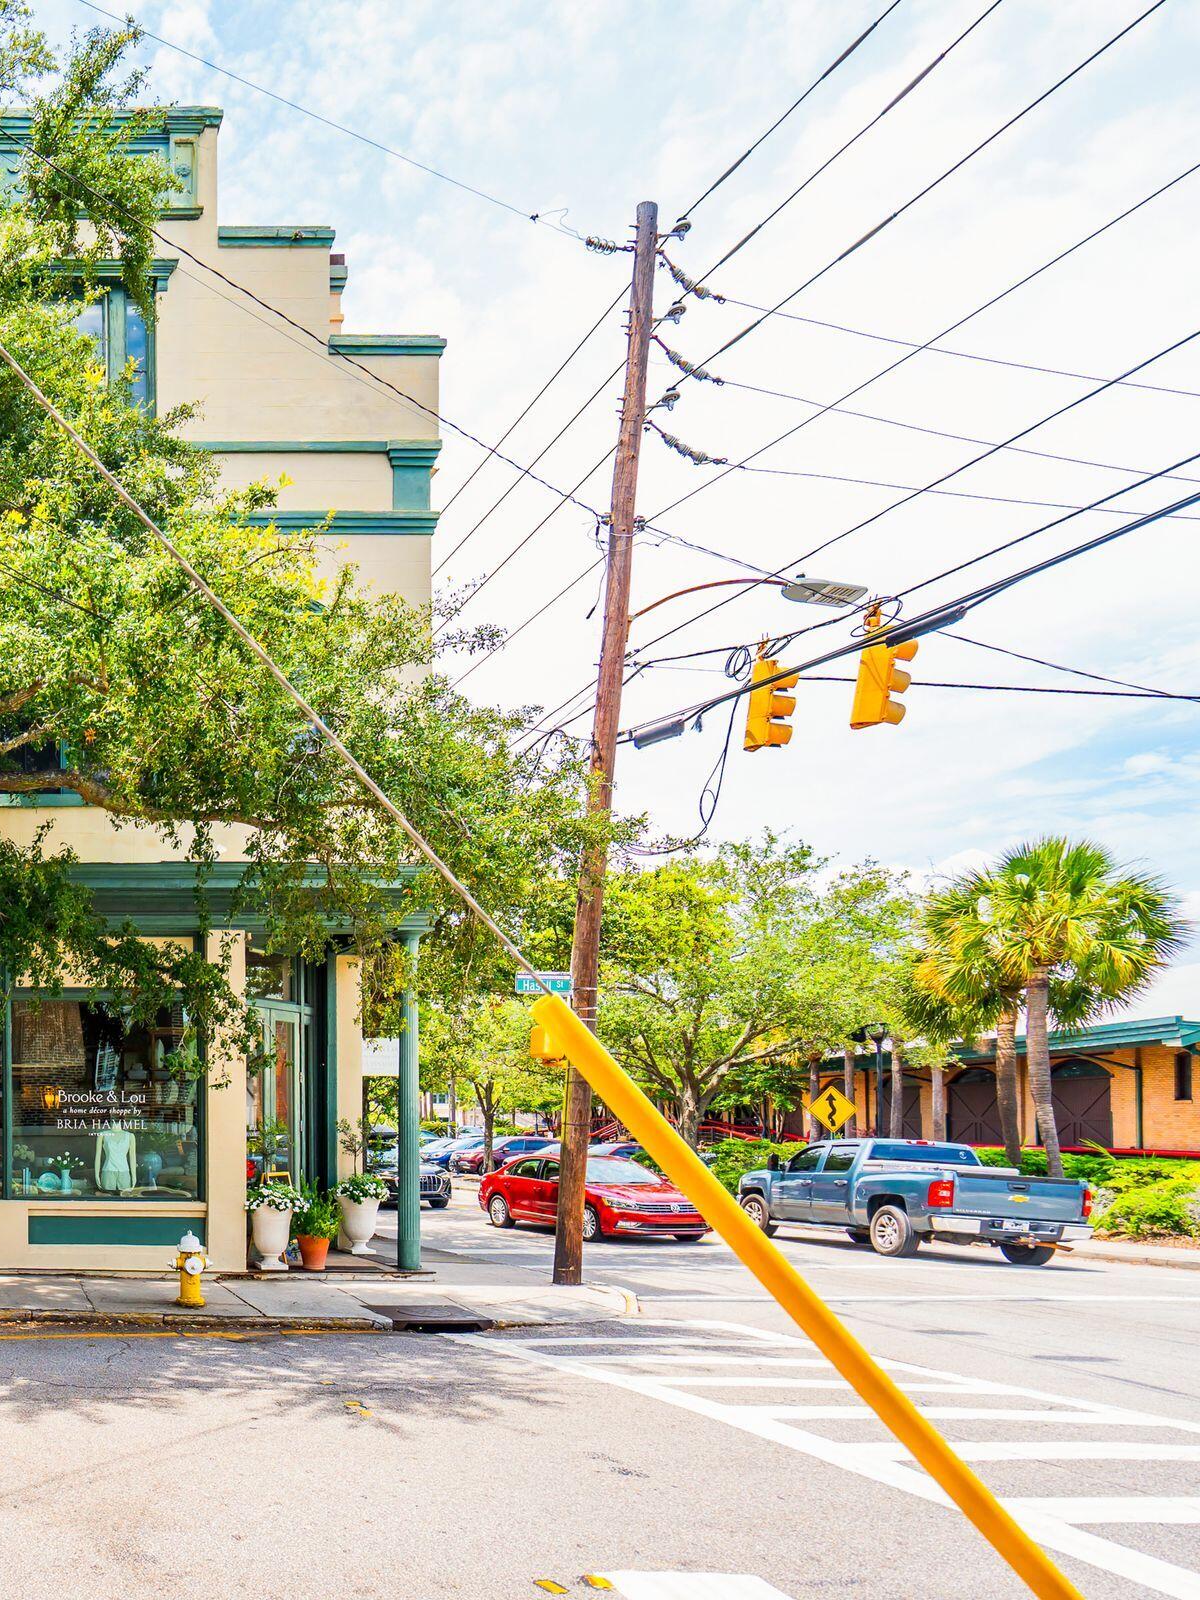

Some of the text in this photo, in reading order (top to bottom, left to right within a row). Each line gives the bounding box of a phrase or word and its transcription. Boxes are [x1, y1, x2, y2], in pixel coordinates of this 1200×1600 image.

[522, 979, 565, 991] Hasll St
[58, 1089, 146, 1103] Brooke & Lou
[69, 1106, 87, 1114] home
[88, 1106, 108, 1114] décor
[109, 1106, 131, 1116] shoppe
[133, 1107, 142, 1116] by
[56, 1118, 148, 1130] BRIA HAMMEL
